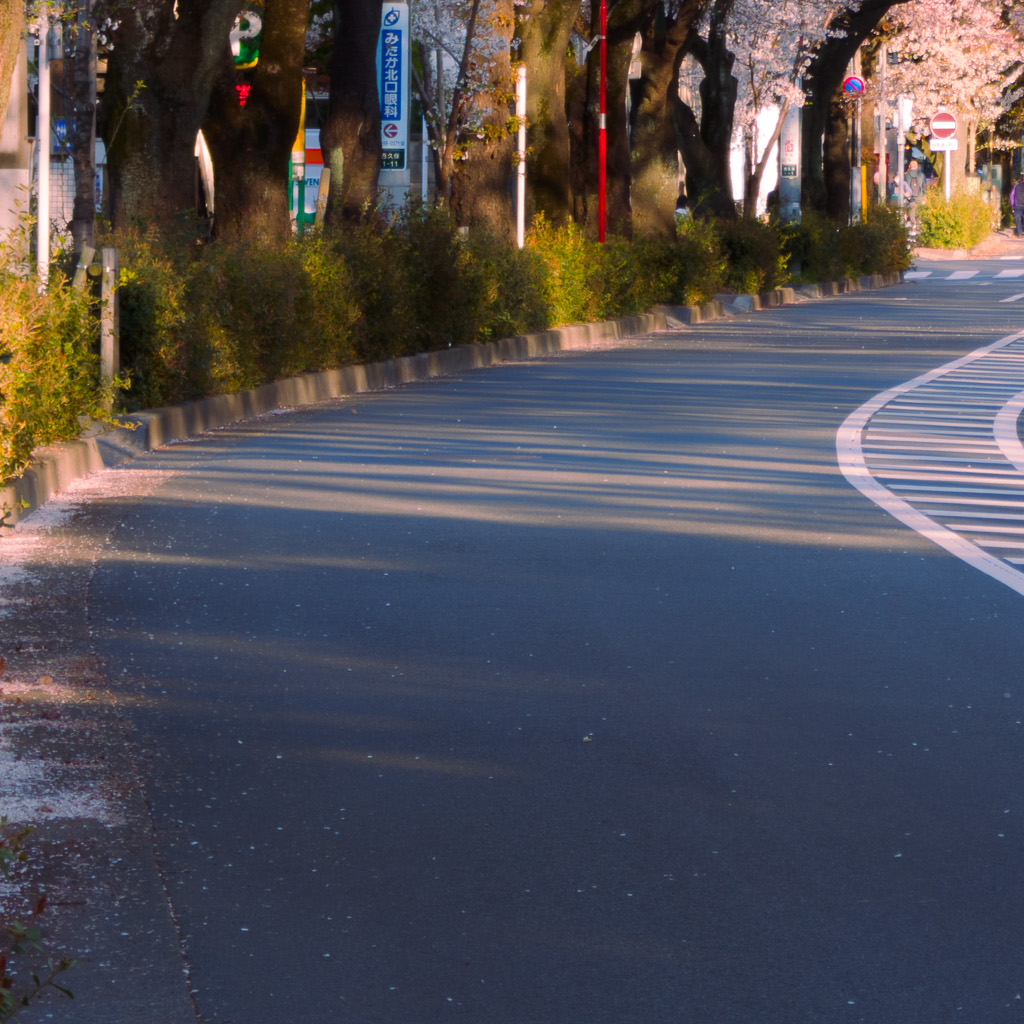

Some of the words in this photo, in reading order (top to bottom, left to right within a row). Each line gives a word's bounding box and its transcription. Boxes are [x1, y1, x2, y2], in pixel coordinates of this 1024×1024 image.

[229, 10, 262, 56] P
[384, 32, 399, 118] みたか北口眼科
